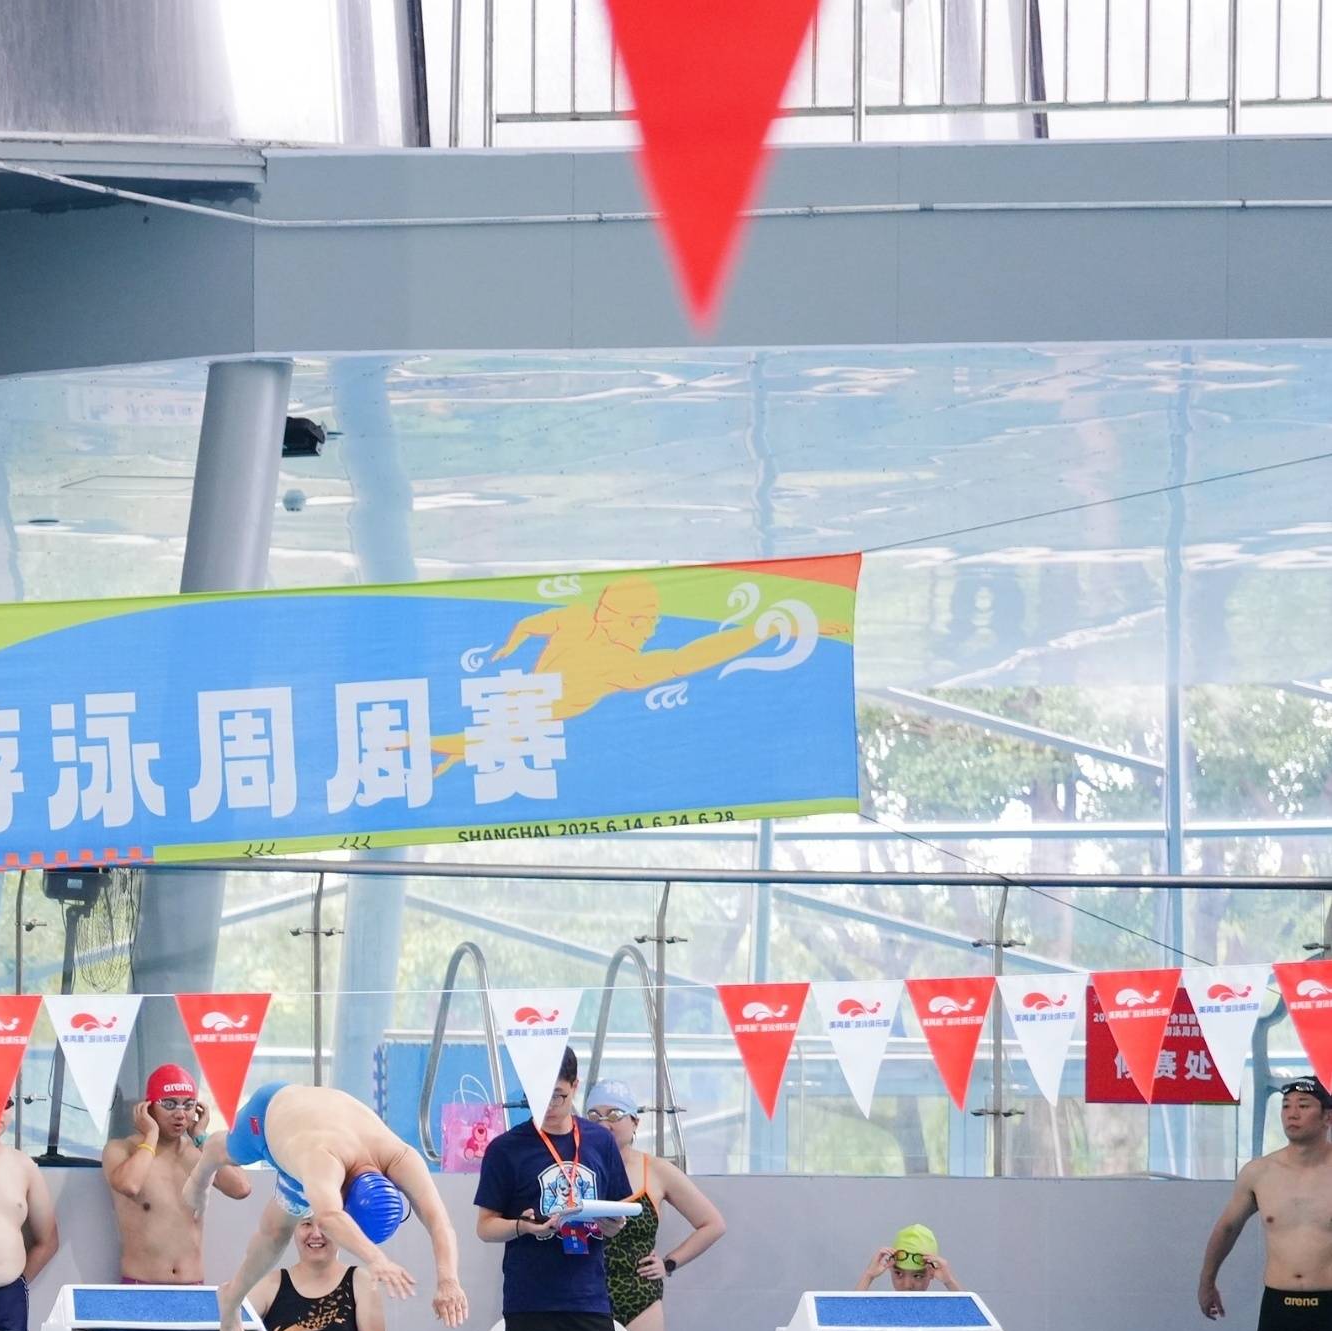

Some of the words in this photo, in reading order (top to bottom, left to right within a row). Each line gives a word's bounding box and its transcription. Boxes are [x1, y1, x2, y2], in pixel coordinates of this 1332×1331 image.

[458, 824, 550, 842] SHANGHAI
[164, 1083, 193, 1092] arena
[1284, 1296, 1319, 1307] arena
